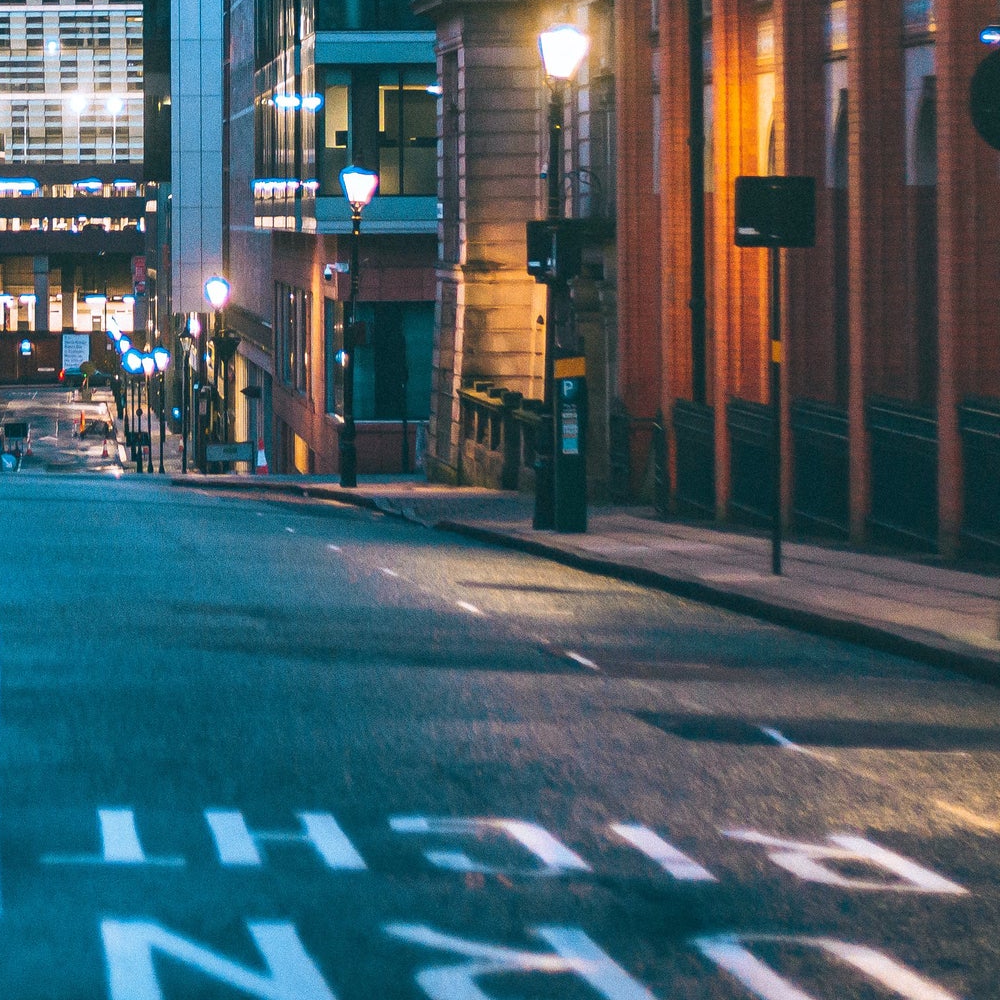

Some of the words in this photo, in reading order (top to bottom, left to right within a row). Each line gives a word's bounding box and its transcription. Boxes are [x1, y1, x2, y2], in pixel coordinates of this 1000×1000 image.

[563, 380, 574, 397] P
[39, 809, 969, 895] RIGHT
[100, 919, 961, 1000] URN
